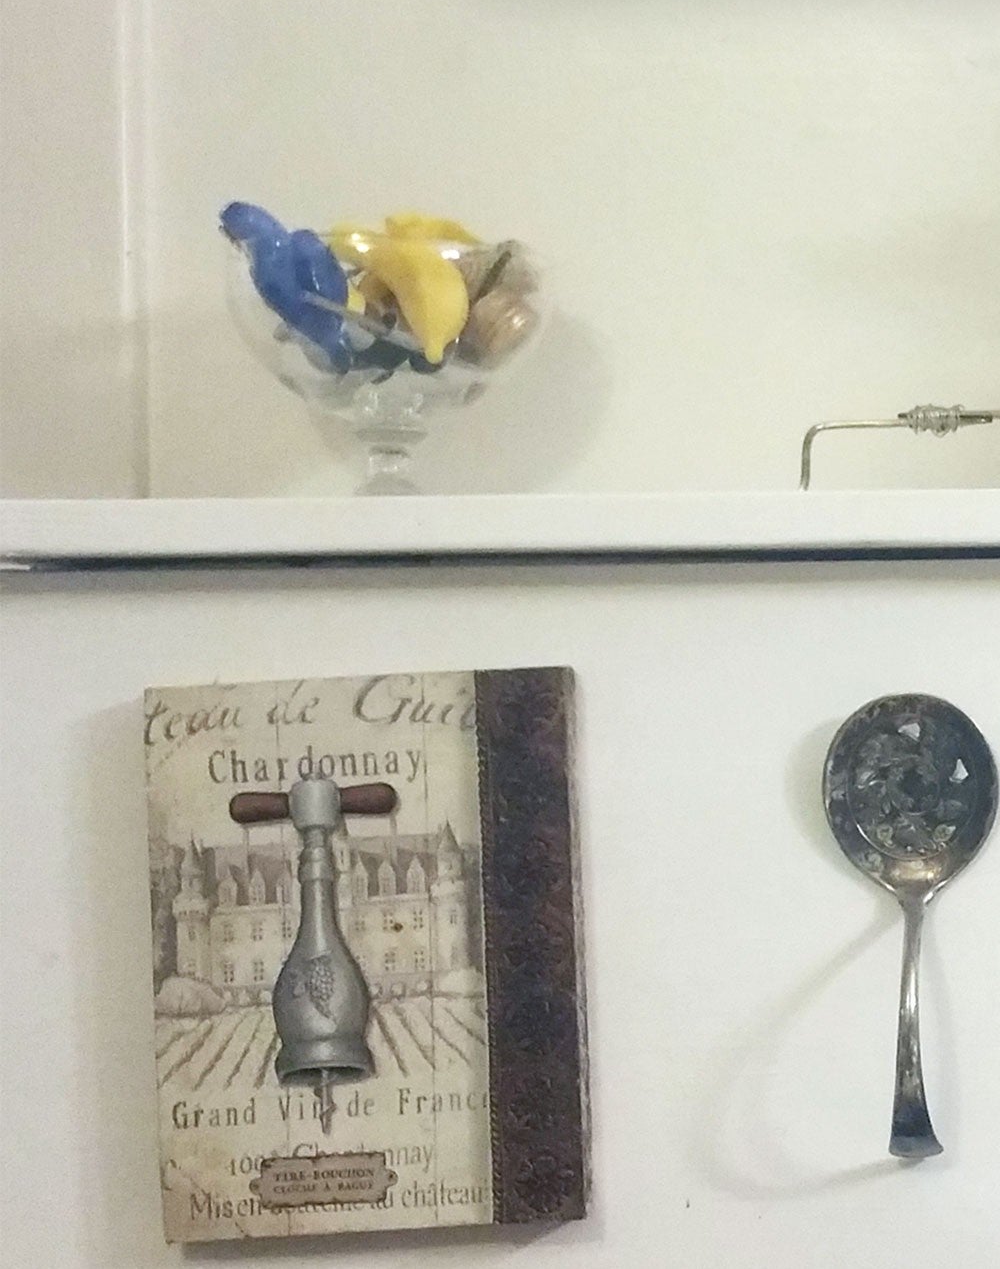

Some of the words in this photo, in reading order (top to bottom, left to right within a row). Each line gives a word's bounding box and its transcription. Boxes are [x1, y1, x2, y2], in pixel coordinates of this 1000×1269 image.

[207, 745, 420, 784] Chardonnay
[172, 1098, 257, 1130] Grand
[278, 1093, 325, 1122] Vin
[346, 1090, 377, 1118] de
